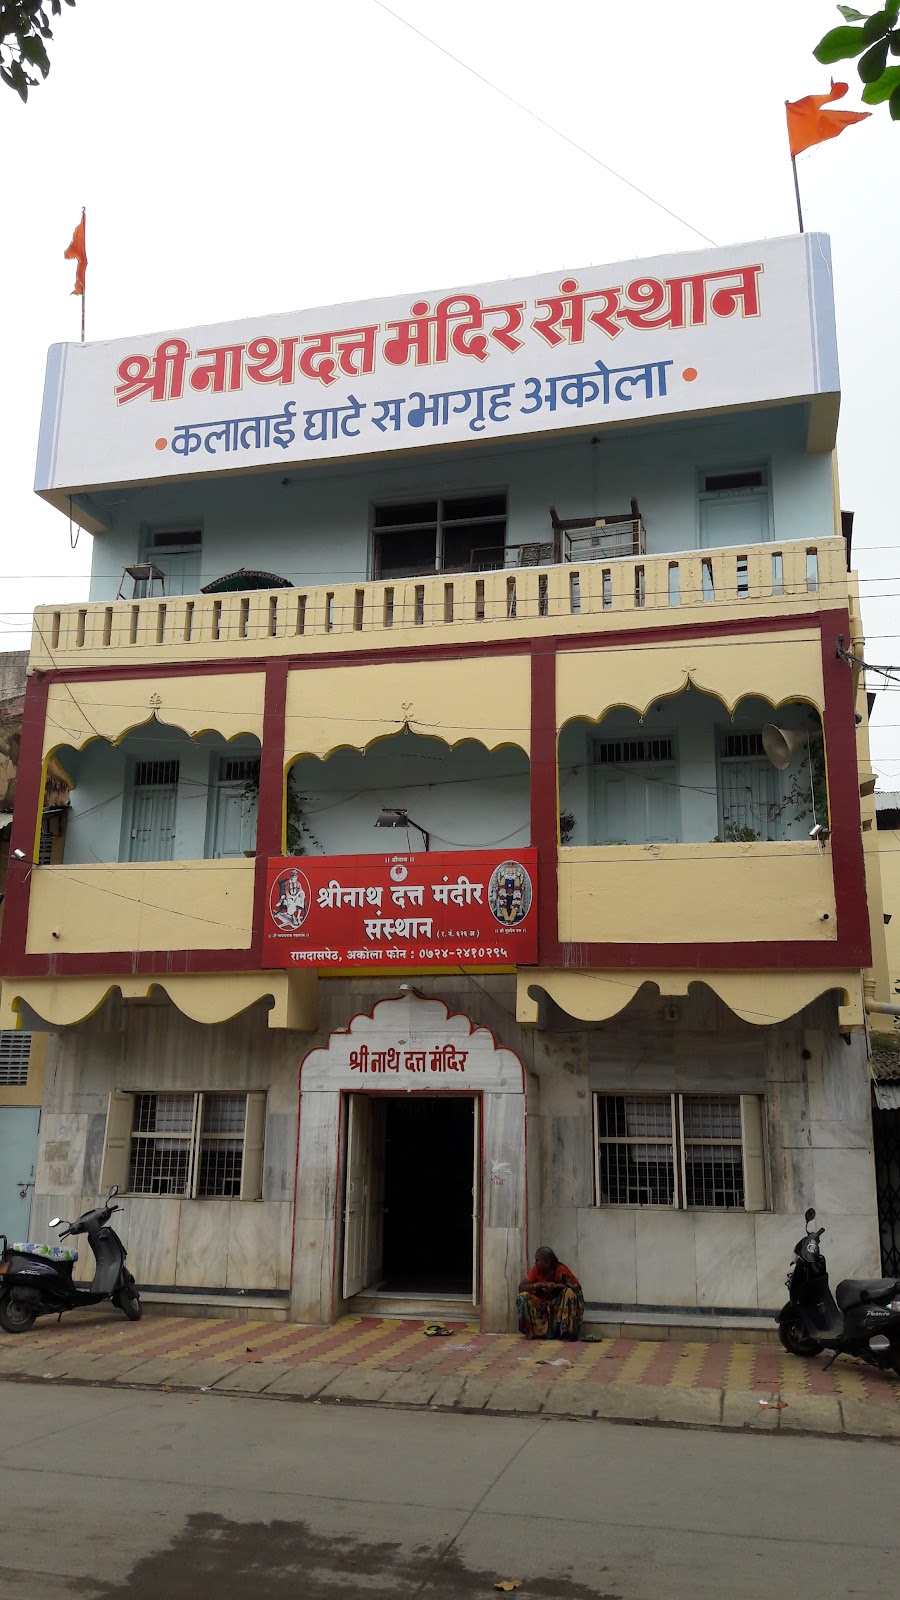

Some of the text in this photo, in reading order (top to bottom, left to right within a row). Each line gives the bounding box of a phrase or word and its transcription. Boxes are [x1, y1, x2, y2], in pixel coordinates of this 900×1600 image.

[114, 263, 764, 407] श्री नाथ दत्त मंदिर संस्थान
[171, 359, 674, 457] कलाताई घाटे सभागृह अकोला
[316, 875, 484, 909] श्रीनाथ दत्त मंदीर
[363, 910, 433, 941] संस्थान
[290, 947, 343, 962] रामदासपेठ,
[346, 946, 384, 961] अकोला
[386, 946, 407, 960] फोन
[349, 1044, 469, 1073] श्री नाथ दत्त मंदिर
